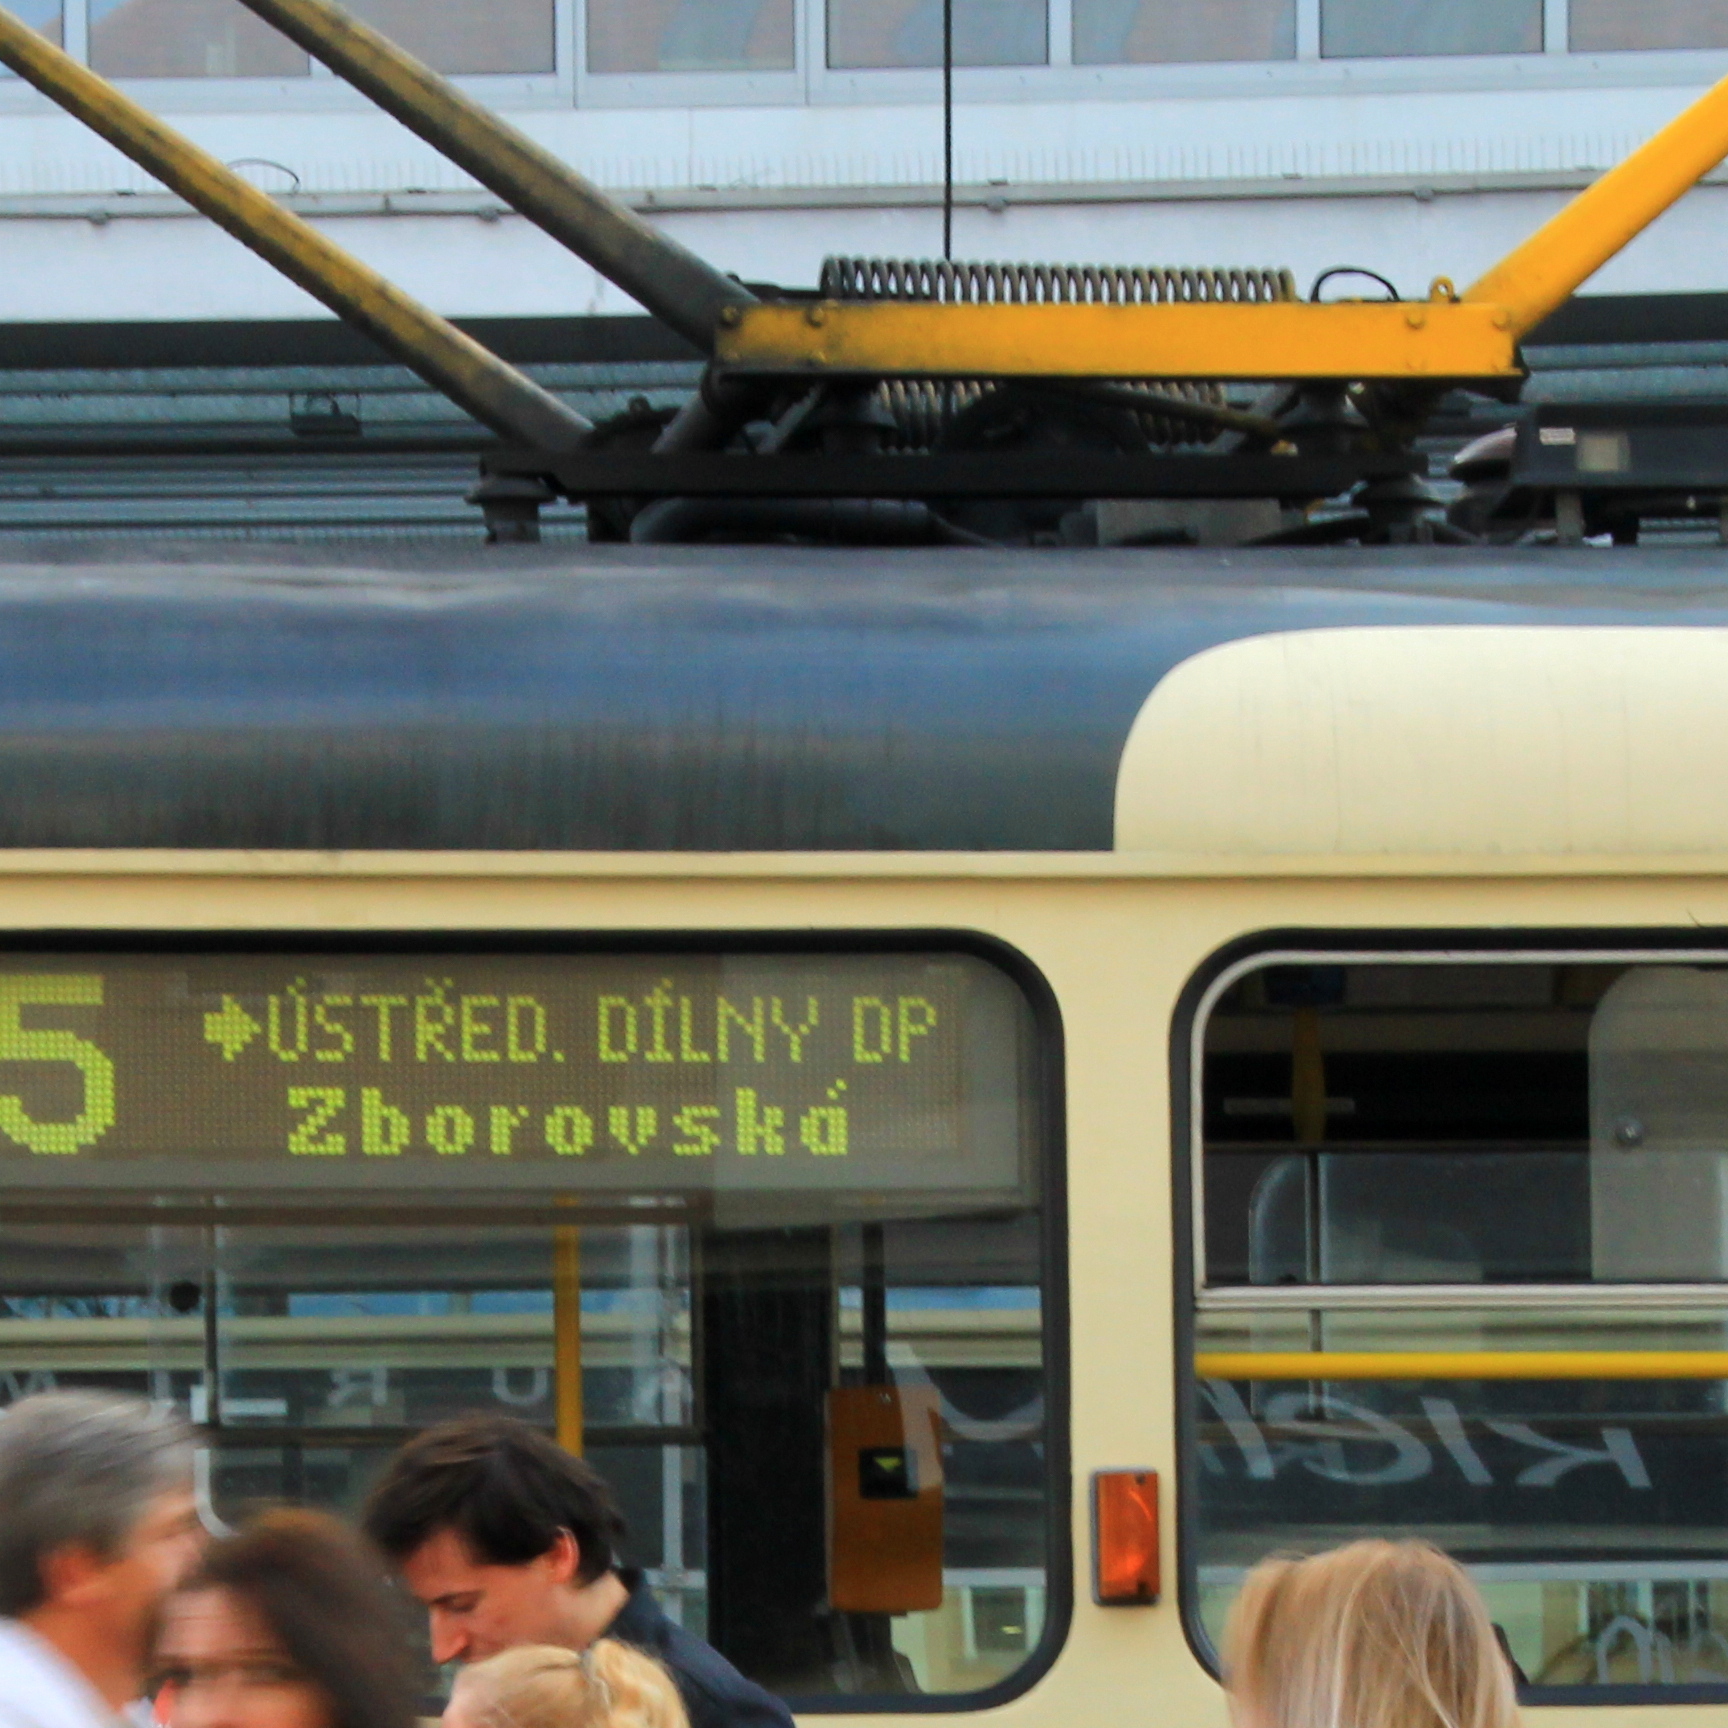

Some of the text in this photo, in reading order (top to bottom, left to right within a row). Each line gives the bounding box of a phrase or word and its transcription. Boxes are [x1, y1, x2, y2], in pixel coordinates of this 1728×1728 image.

[270, 976, 937, 1062] ÚSTŘED. DÍLNY DP
[288, 1079, 849, 1155] Zborovská
